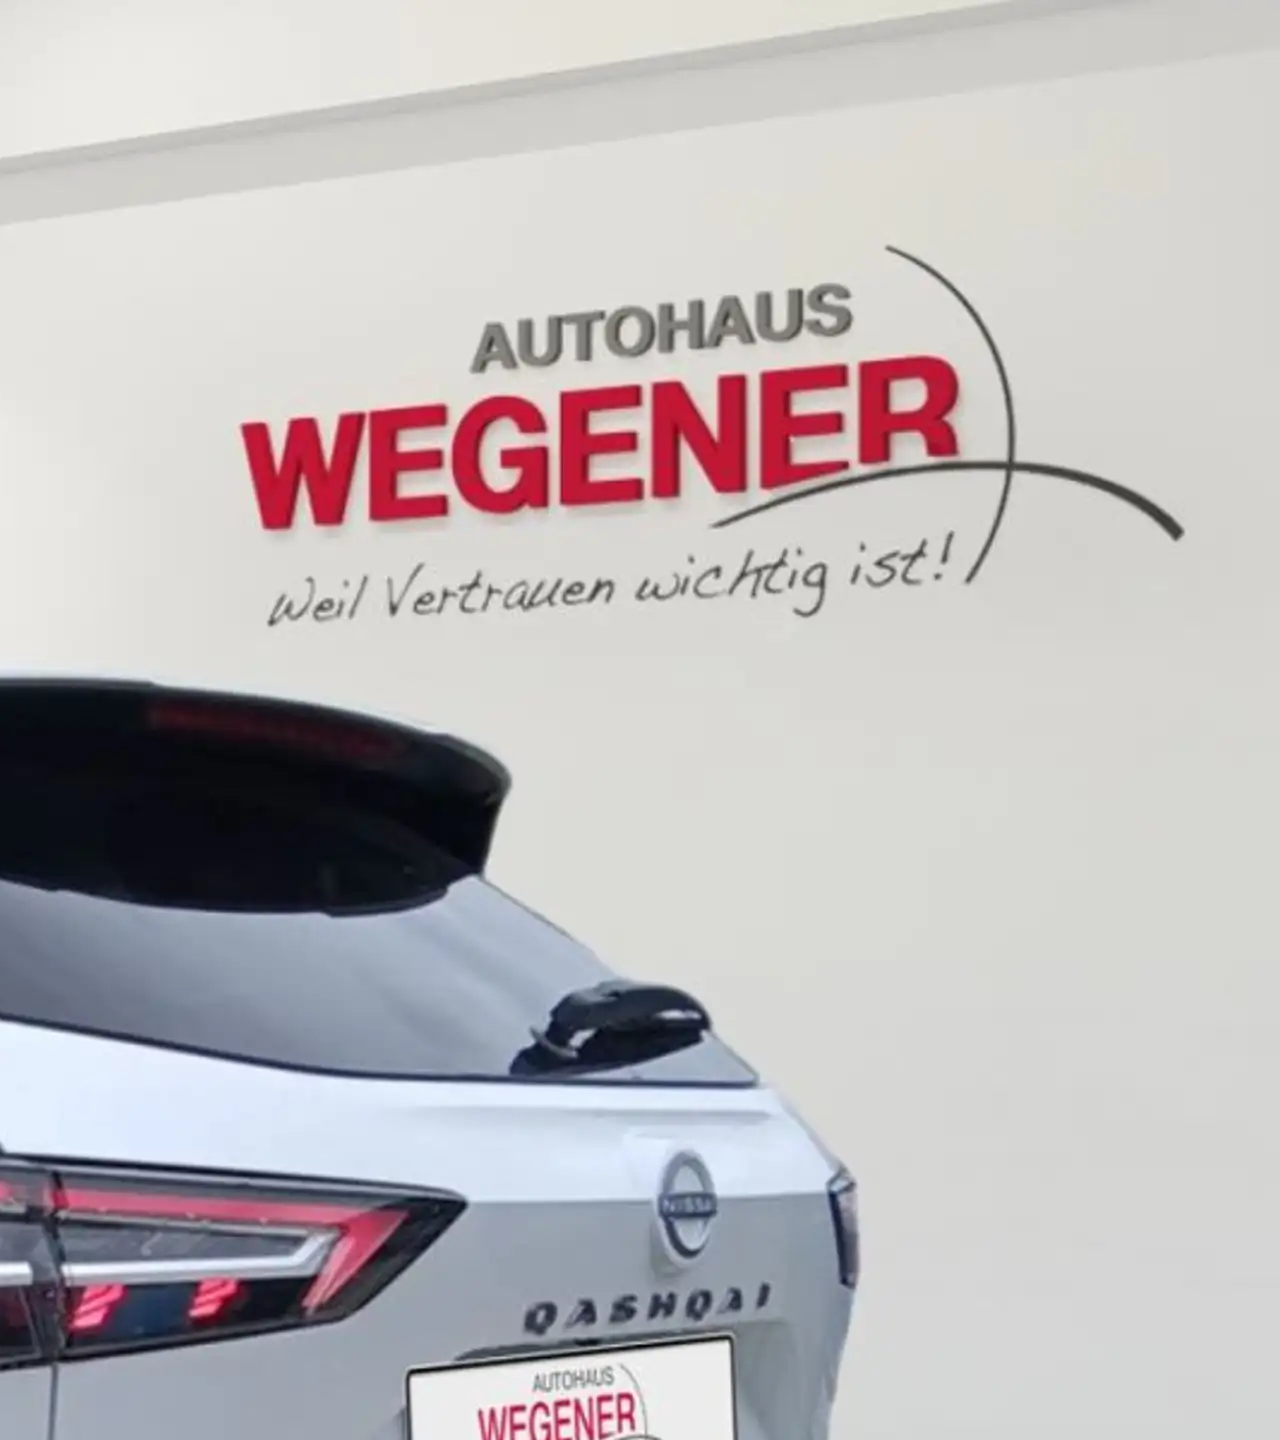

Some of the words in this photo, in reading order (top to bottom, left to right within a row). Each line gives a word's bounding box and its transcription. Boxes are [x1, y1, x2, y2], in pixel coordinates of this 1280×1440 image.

[470, 283, 854, 374] AUTOHAUS
[241, 355, 960, 531] WEGENER
[386, 561, 616, 618] Vertrauen
[634, 546, 829, 618] wichtig
[849, 530, 956, 589] ist!
[523, 1281, 772, 1336] QASHQAI
[532, 1365, 616, 1393] AUTOHAUS
